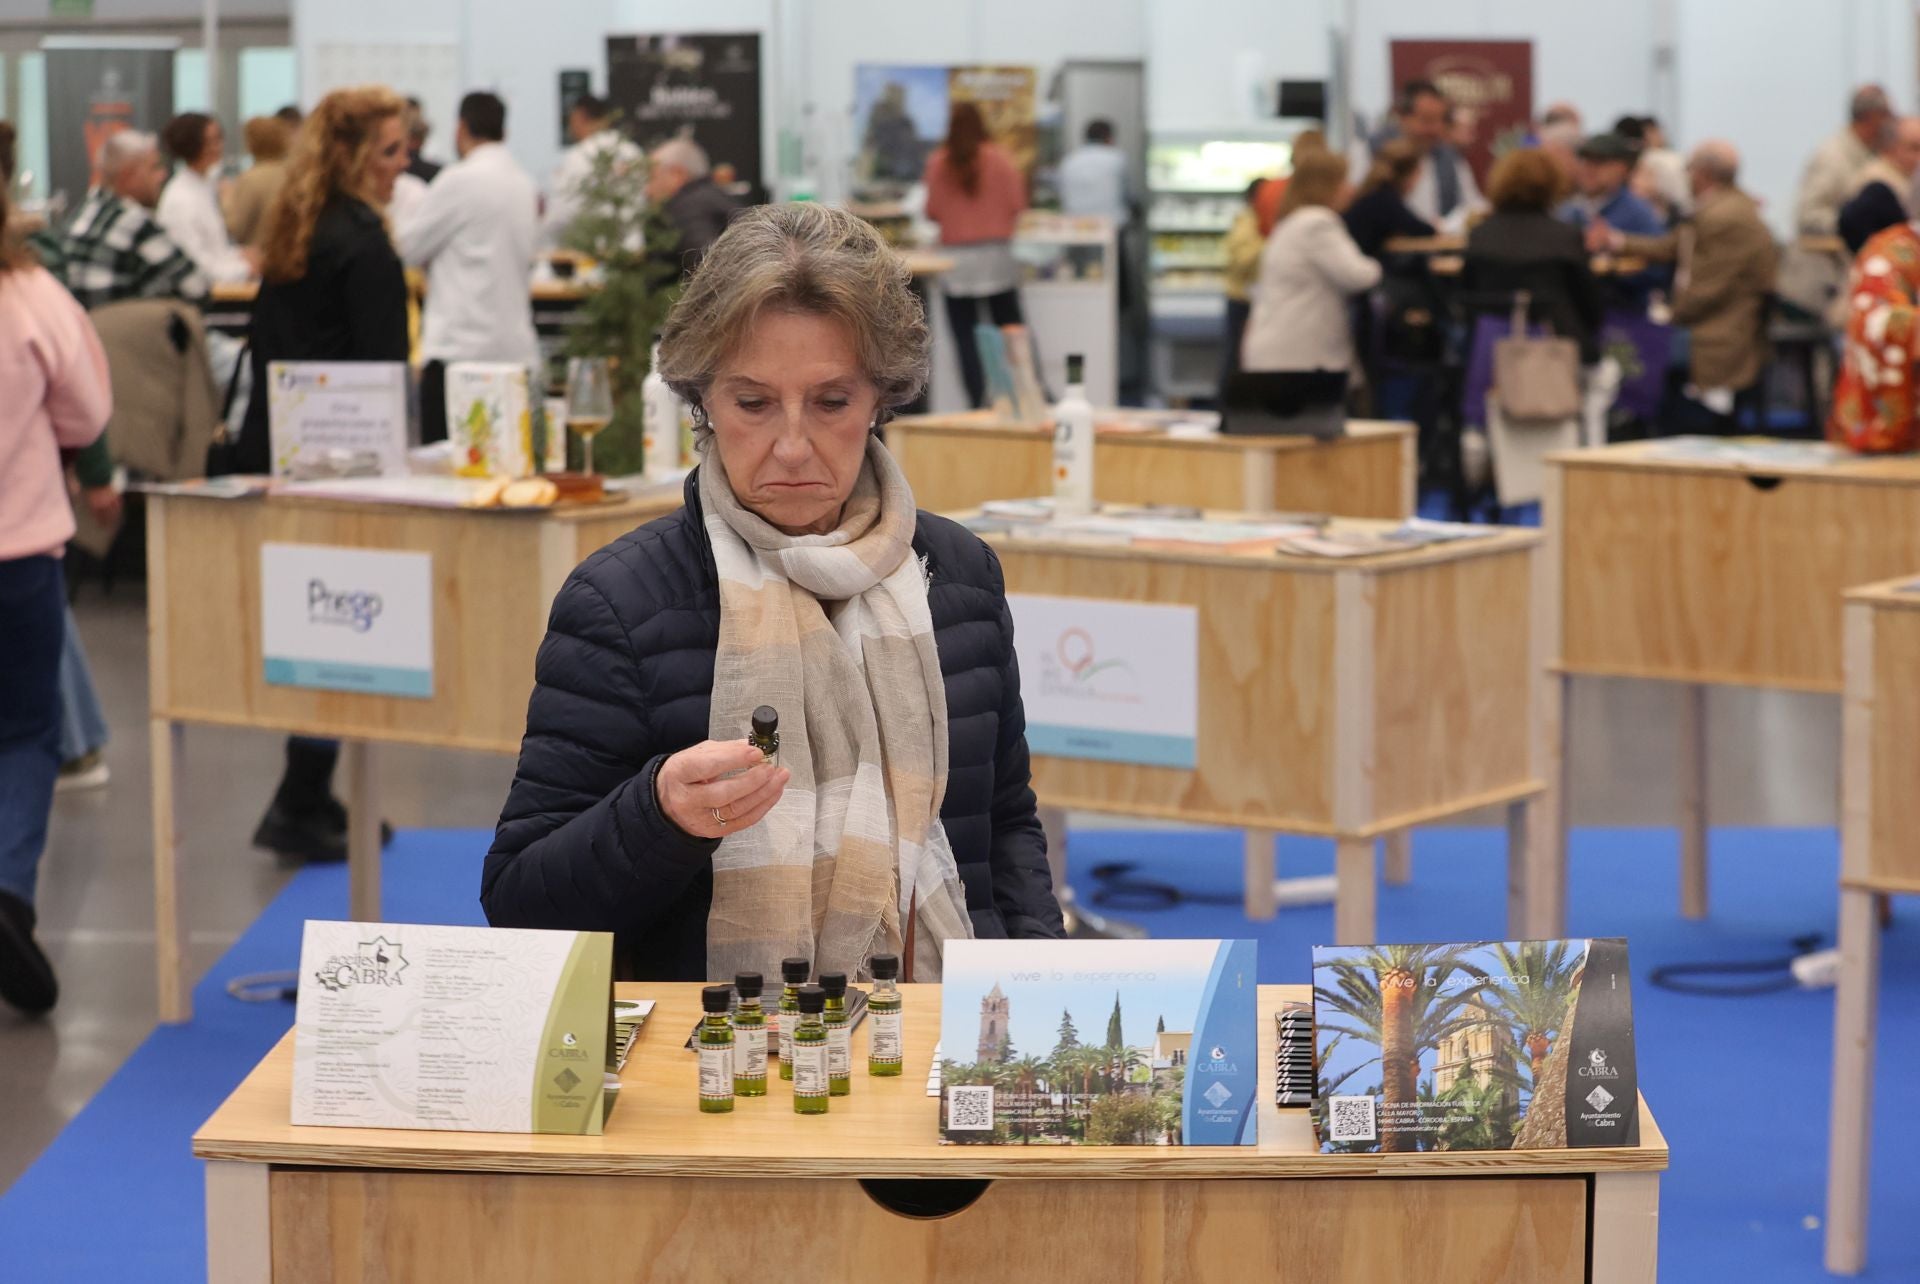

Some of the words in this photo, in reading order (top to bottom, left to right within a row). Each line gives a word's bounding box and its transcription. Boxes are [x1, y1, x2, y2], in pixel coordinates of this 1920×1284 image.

[336, 965, 404, 989] CABRA
[1010, 971, 1041, 982] vive
[1447, 975, 1530, 990] experiencia
[548, 1048, 589, 1058] CABRA
[1198, 1063, 1239, 1072] CABRA
[1578, 1066, 1619, 1077] CABRA
[1580, 1112, 1622, 1120] Ayuntamiento
[1594, 1118, 1616, 1127] Cabra
